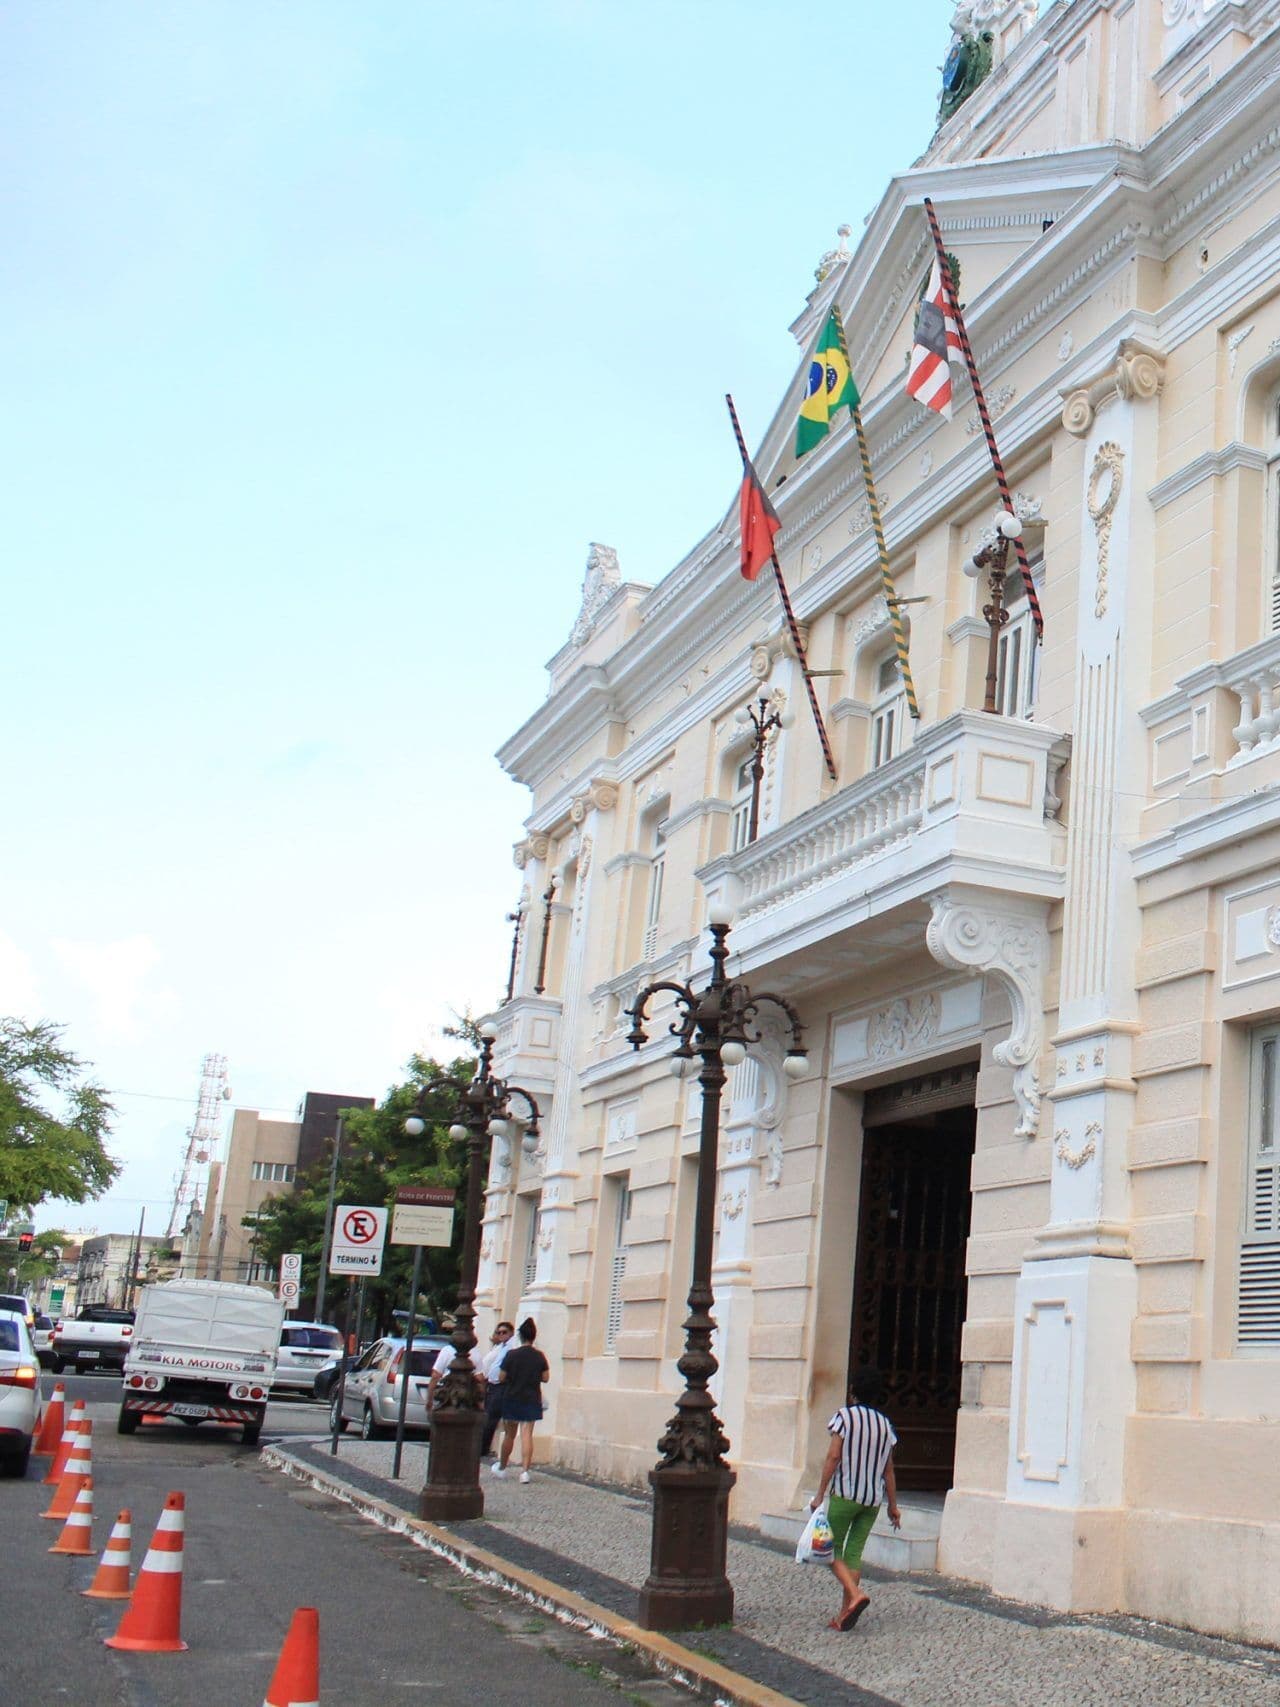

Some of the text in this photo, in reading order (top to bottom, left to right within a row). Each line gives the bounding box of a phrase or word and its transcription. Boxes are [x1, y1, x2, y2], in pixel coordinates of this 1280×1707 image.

[353, 1217, 367, 1236] E
[162, 1355, 184, 1366] KIA
[188, 1358, 241, 1372] MOTORS
